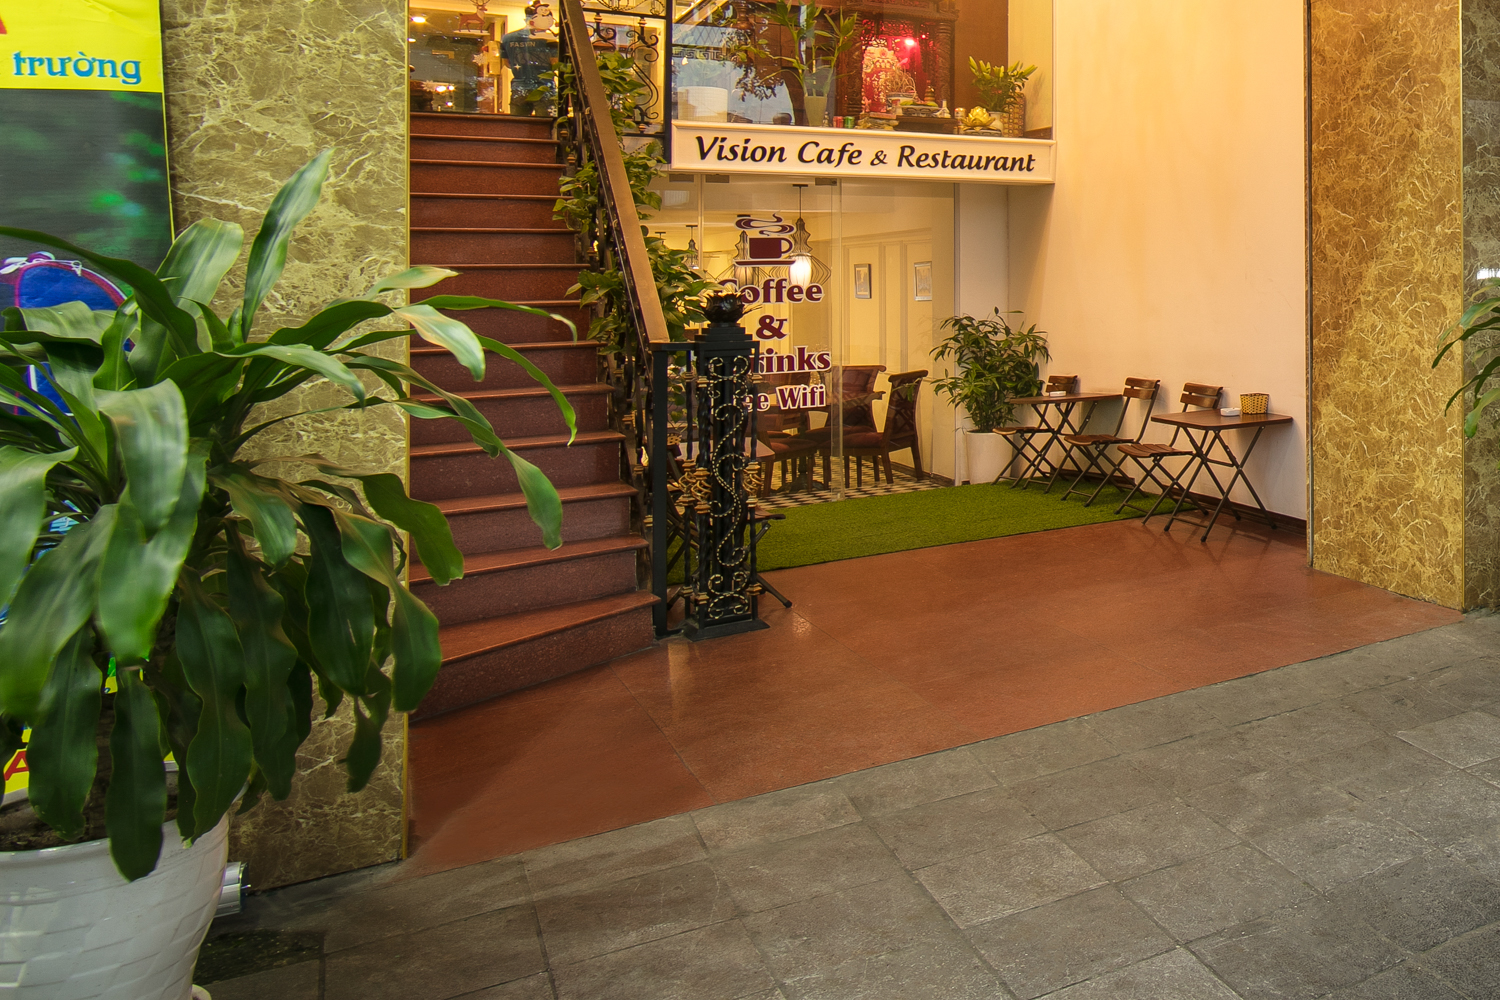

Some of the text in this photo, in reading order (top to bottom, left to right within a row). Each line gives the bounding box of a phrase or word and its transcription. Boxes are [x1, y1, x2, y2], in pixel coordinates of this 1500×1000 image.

[12, 51, 142, 85] trường
[695, 136, 1036, 173] Vision Cafe & Restaurant
[755, 314, 788, 340] &
[748, 346, 832, 375] rinks
[776, 384, 827, 410] Wifi
